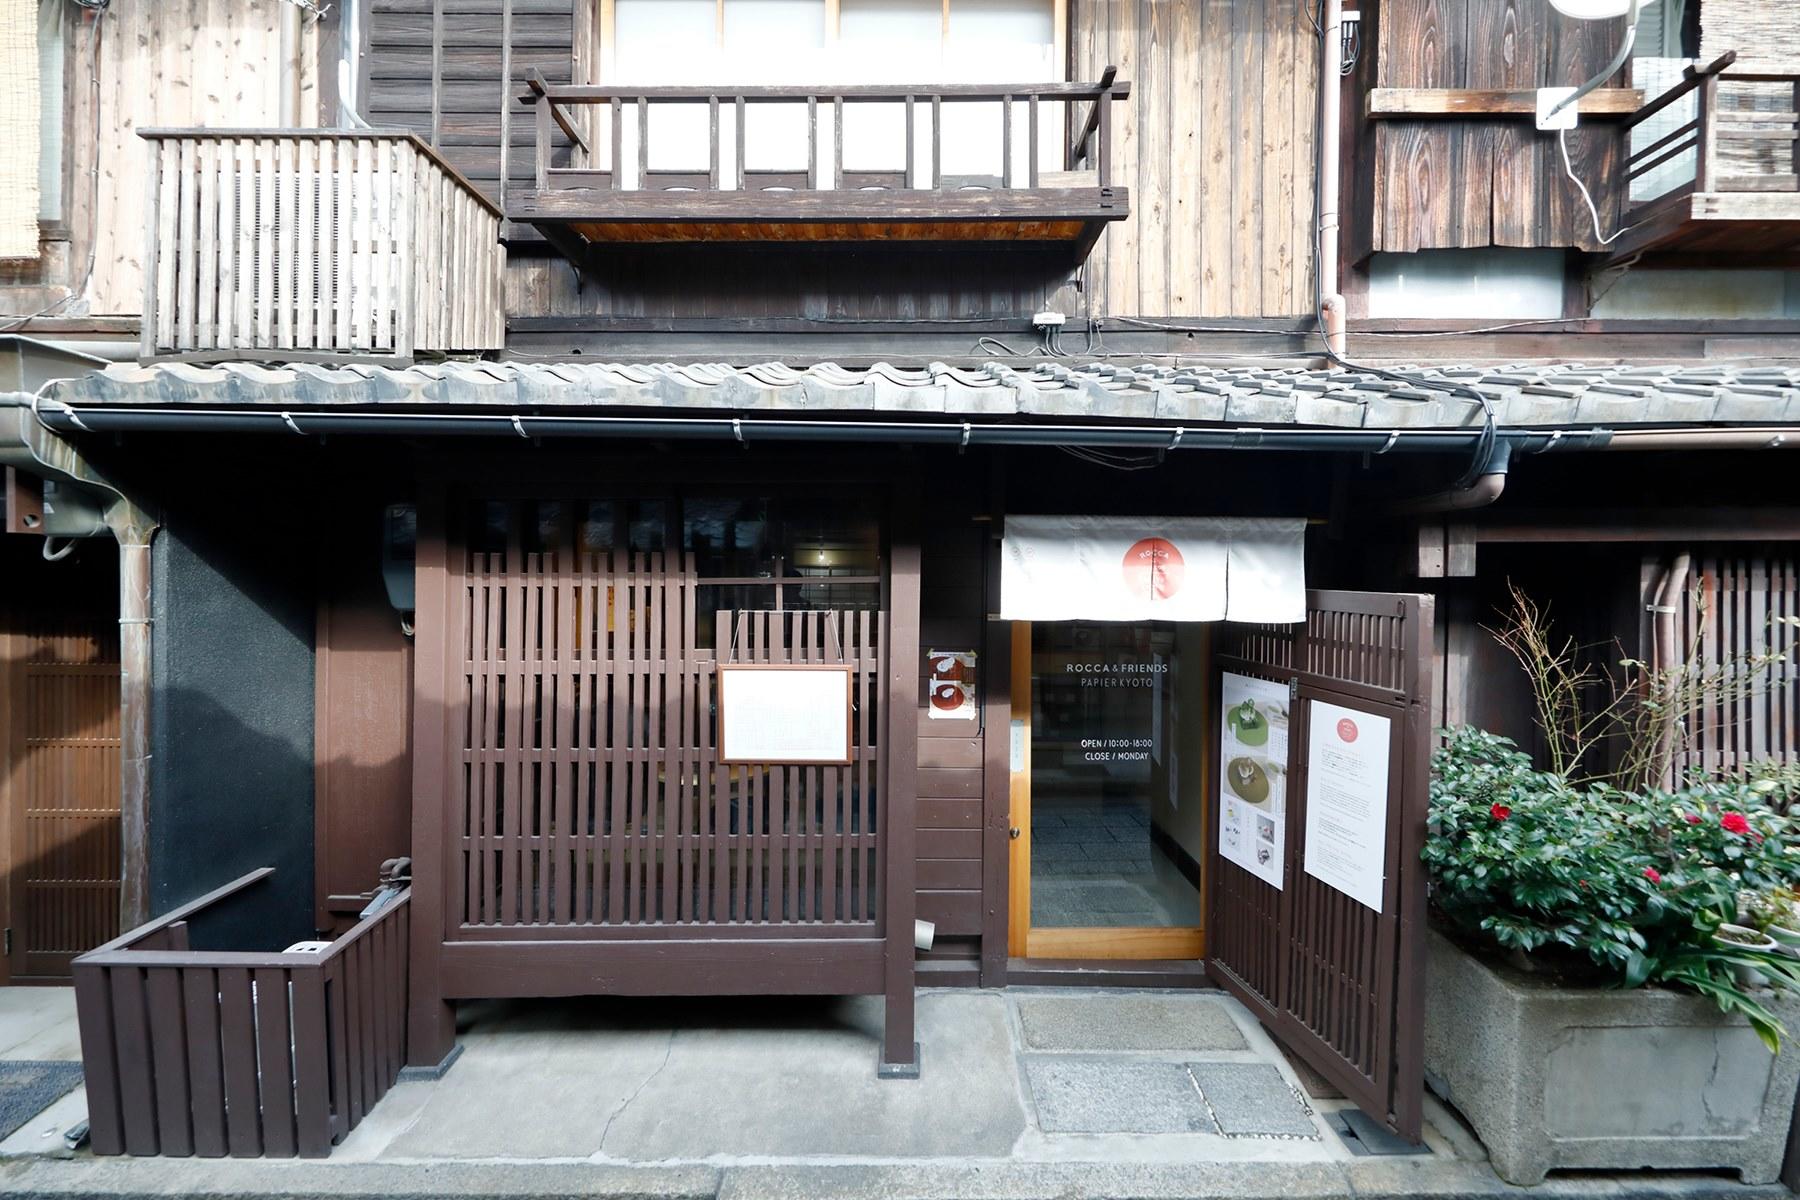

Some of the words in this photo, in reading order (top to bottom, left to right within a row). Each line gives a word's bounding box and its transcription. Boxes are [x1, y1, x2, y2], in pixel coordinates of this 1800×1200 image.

[1066, 664, 1110, 673] ROCCA
[1112, 664, 1118, 673] &
[1121, 664, 1168, 673] FRIENDS
[1081, 678, 1117, 688] PAPIER
[1119, 678, 1153, 688] KYOTO
[1081, 739, 1102, 748] OPEN
[1085, 752, 1110, 761] CLOSE
[1118, 752, 1149, 761] MONDAY
